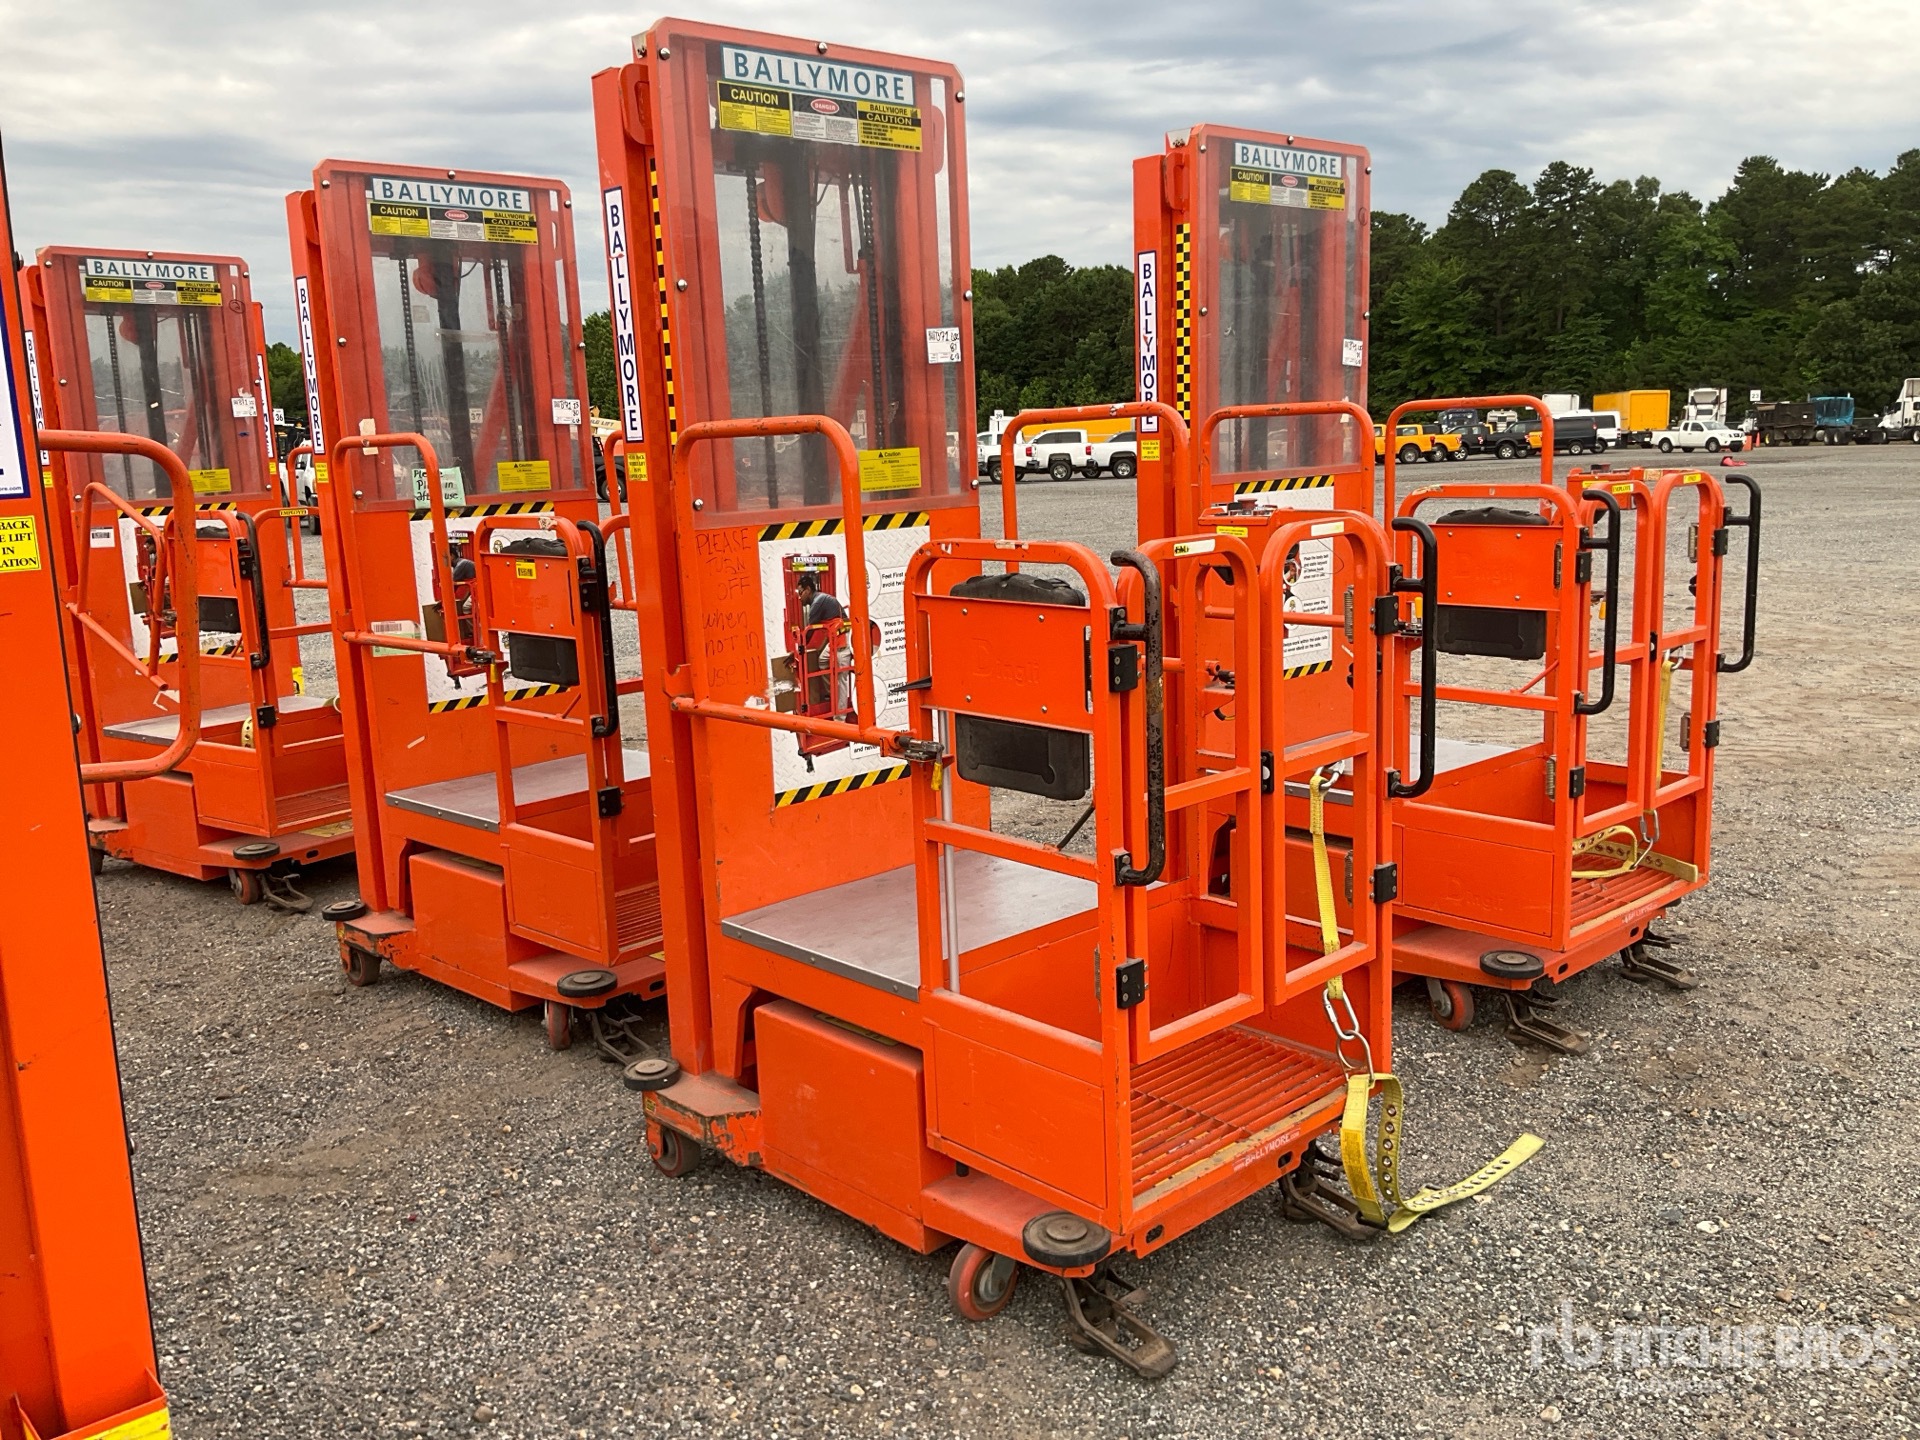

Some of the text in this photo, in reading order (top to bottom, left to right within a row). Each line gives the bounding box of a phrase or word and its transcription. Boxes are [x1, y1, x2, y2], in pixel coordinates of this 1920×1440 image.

[734, 52, 905, 101] BALLYMORE
[730, 88, 779, 106] CAUTION
[814, 102, 836, 111] DANGER
[869, 104, 908, 116] BALLYMORE
[866, 113, 912, 126] CAUTION
[1241, 145, 1337, 175] BALLYMORE
[1237, 171, 1264, 182] CAUTION
[382, 181, 523, 209] BALLYMORE
[379, 206, 419, 216] CAUTION
[494, 212, 526, 220] BALLYMORE
[491, 219, 530, 227] CAUTION
[93, 260, 209, 280] BALLYMORE
[92, 279, 125, 288] CAUTION
[610, 204, 638, 431] BALLYMORE
[300, 288, 322, 447] BALLYMORE
[275, 413, 284, 422] 36
[471, 413, 481, 421] 37
[9, 532, 33, 542] LIFT
[695, 528, 752, 556] PLEASE
[2, 547, 15, 555] IN
[717, 576, 751, 600] OFF
[703, 609, 748, 631] when
